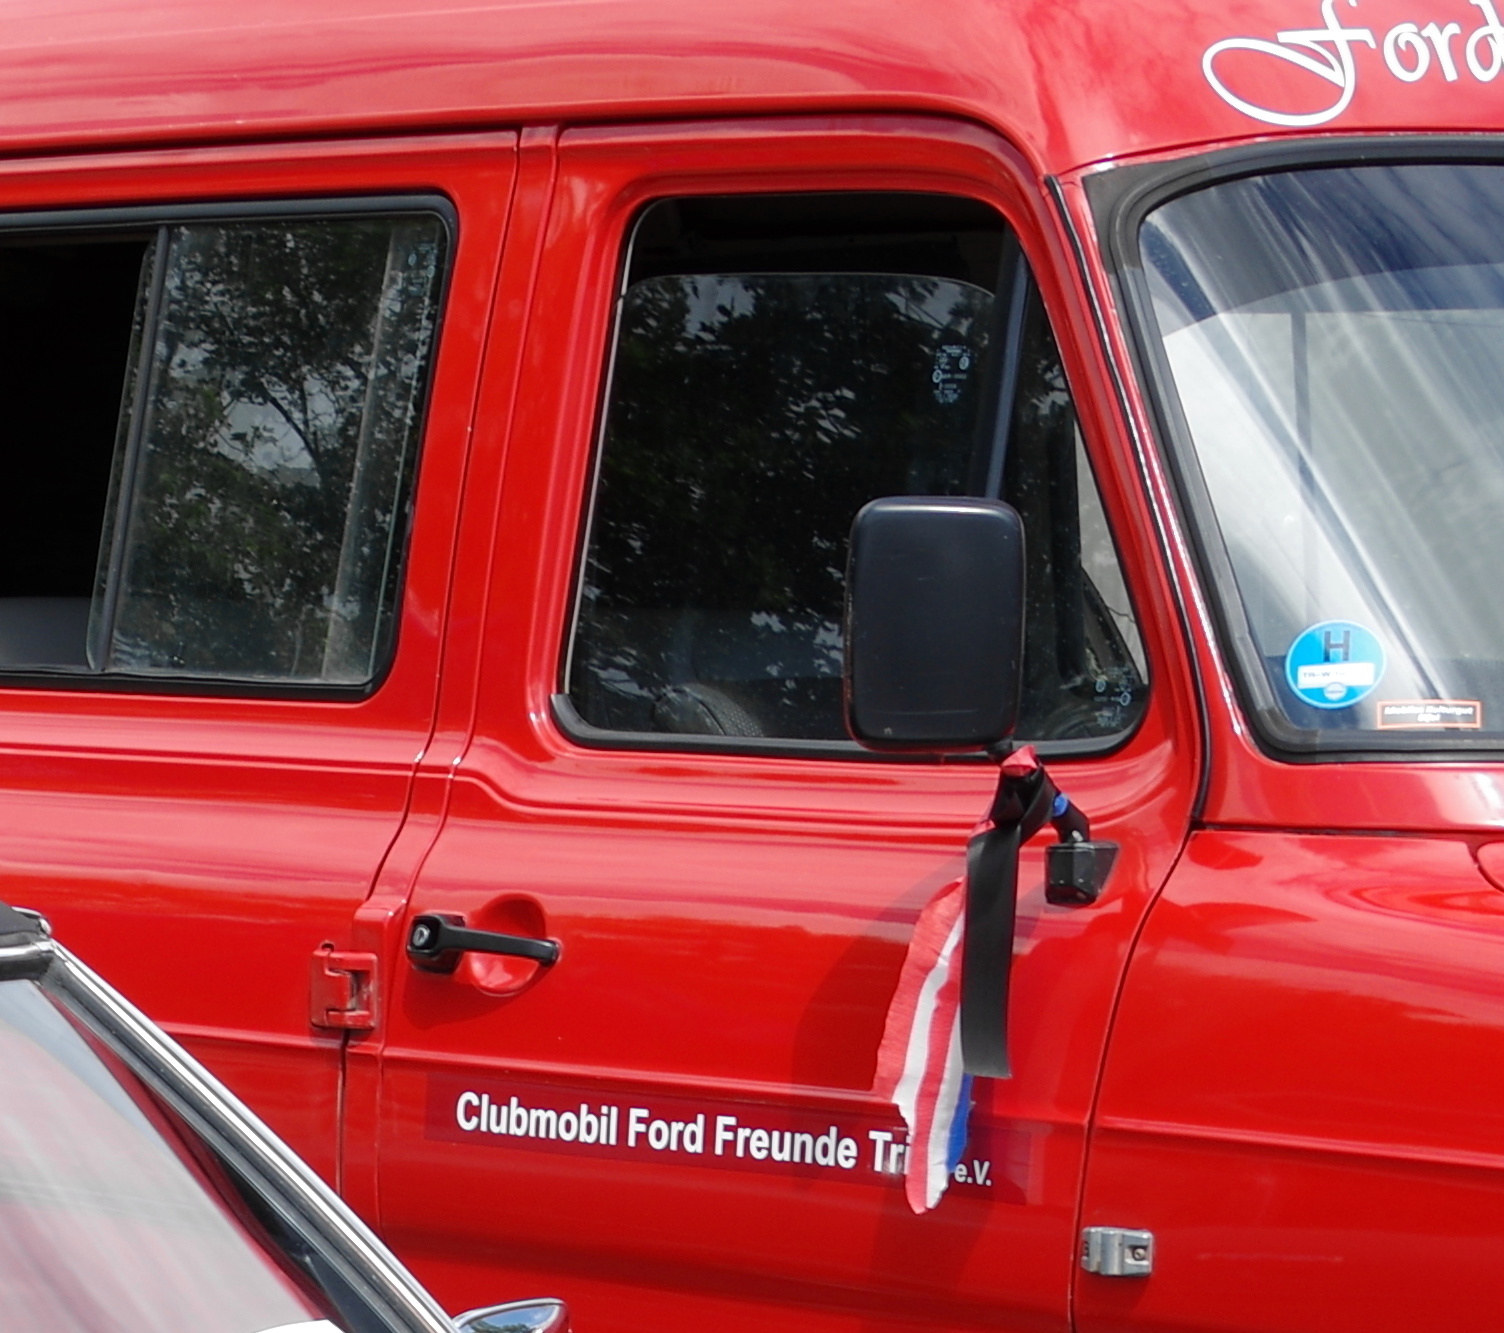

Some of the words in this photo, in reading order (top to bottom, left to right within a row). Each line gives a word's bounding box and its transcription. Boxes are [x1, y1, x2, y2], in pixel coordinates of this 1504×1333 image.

[1323, 630, 1351, 663] H
[455, 1090, 618, 1147] Clubmobil
[627, 1108, 704, 1154] Ford
[715, 1114, 858, 1170] Freunde
[954, 1159, 993, 1188] e.V.
